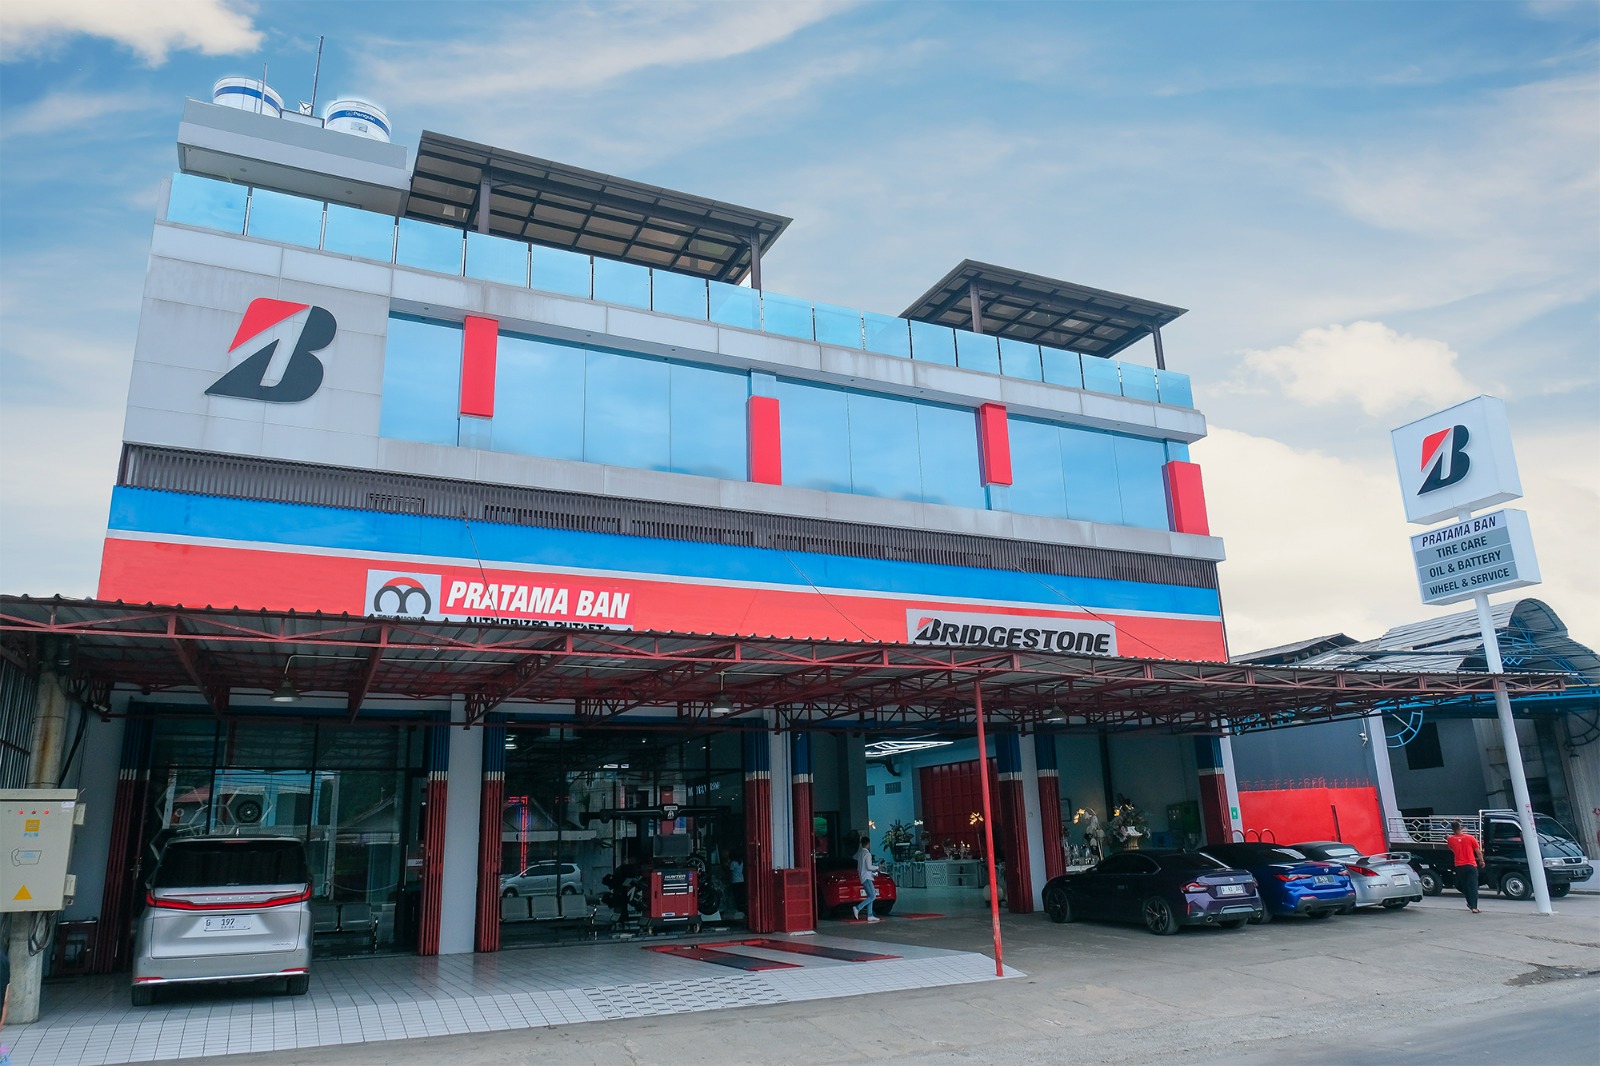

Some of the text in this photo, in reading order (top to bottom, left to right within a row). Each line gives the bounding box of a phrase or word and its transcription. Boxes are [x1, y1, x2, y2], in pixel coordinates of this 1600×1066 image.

[1422, 516, 1496, 547] PRATAMA BAN
[1436, 536, 1488, 559] TIRE CARE
[1429, 550, 1502, 578] OIL & BATTERY
[1429, 567, 1510, 596] WHEEL & SERVICE
[446, 580, 630, 619] PRATAMA BAN
[915, 617, 1110, 653] BRIDGESTONE
